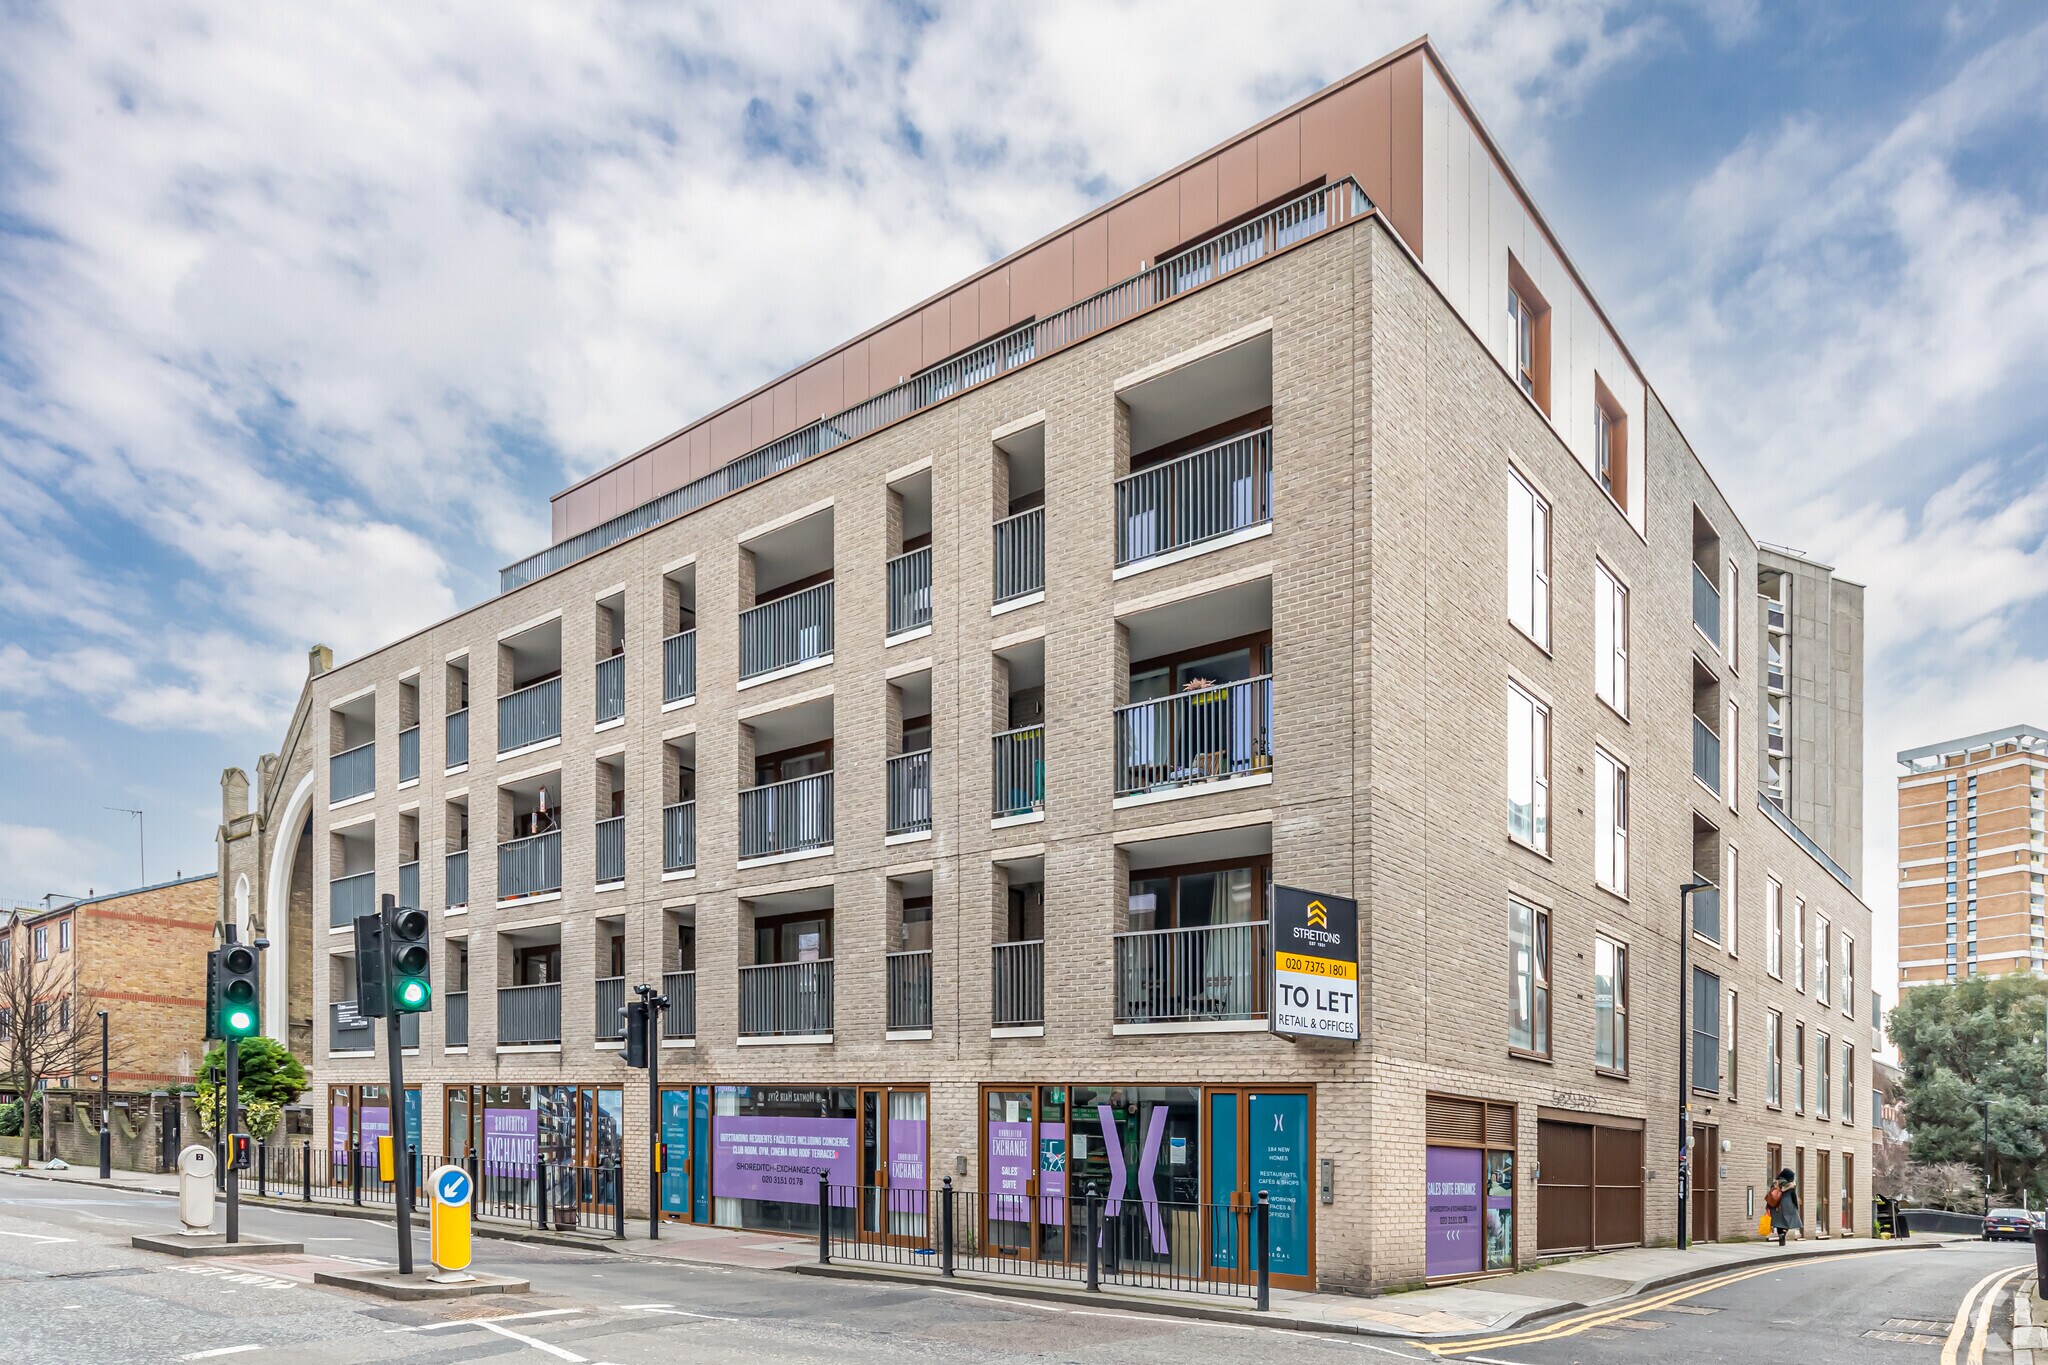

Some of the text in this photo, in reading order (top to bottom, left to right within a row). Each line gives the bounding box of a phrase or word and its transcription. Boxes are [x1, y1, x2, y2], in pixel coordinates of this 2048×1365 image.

[1293, 927, 1340, 944] STRETTONS
[1285, 958, 1346, 976] 020 7375 1801
[1279, 983, 1353, 1014] TO LET
[1279, 1014, 1354, 1033] RETAIL & OFFICES
[720, 1133, 850, 1147] OUTSTANDING RESIDENTS FACILITIES INCLUDING CONCIERGE,
[486, 1137, 536, 1171] EXCHANGE
[732, 1145, 744, 1154] CLUB
[744, 1146, 758, 1155] ROOM,
[770, 1147, 788, 1157] CINEMA
[788, 1148, 798, 1157] AND
[798, 1148, 810, 1157] ROOF
[992, 1139, 1028, 1157] EXCHANGE
[736, 1162, 831, 1175] SHOREDITCH-EXCHANGE.COUK
[892, 1162, 923, 1179] EXCHANGE
[1001, 1166, 1018, 1176] SALES
[1260, 1170, 1298, 1178] RESTAURANTS,
[762, 1175, 803, 1185] 020 3151 0178
[1002, 1180, 1017, 1189] SUITE
[1427, 1182, 1477, 1195] SALES SUITE ENTRANCE
